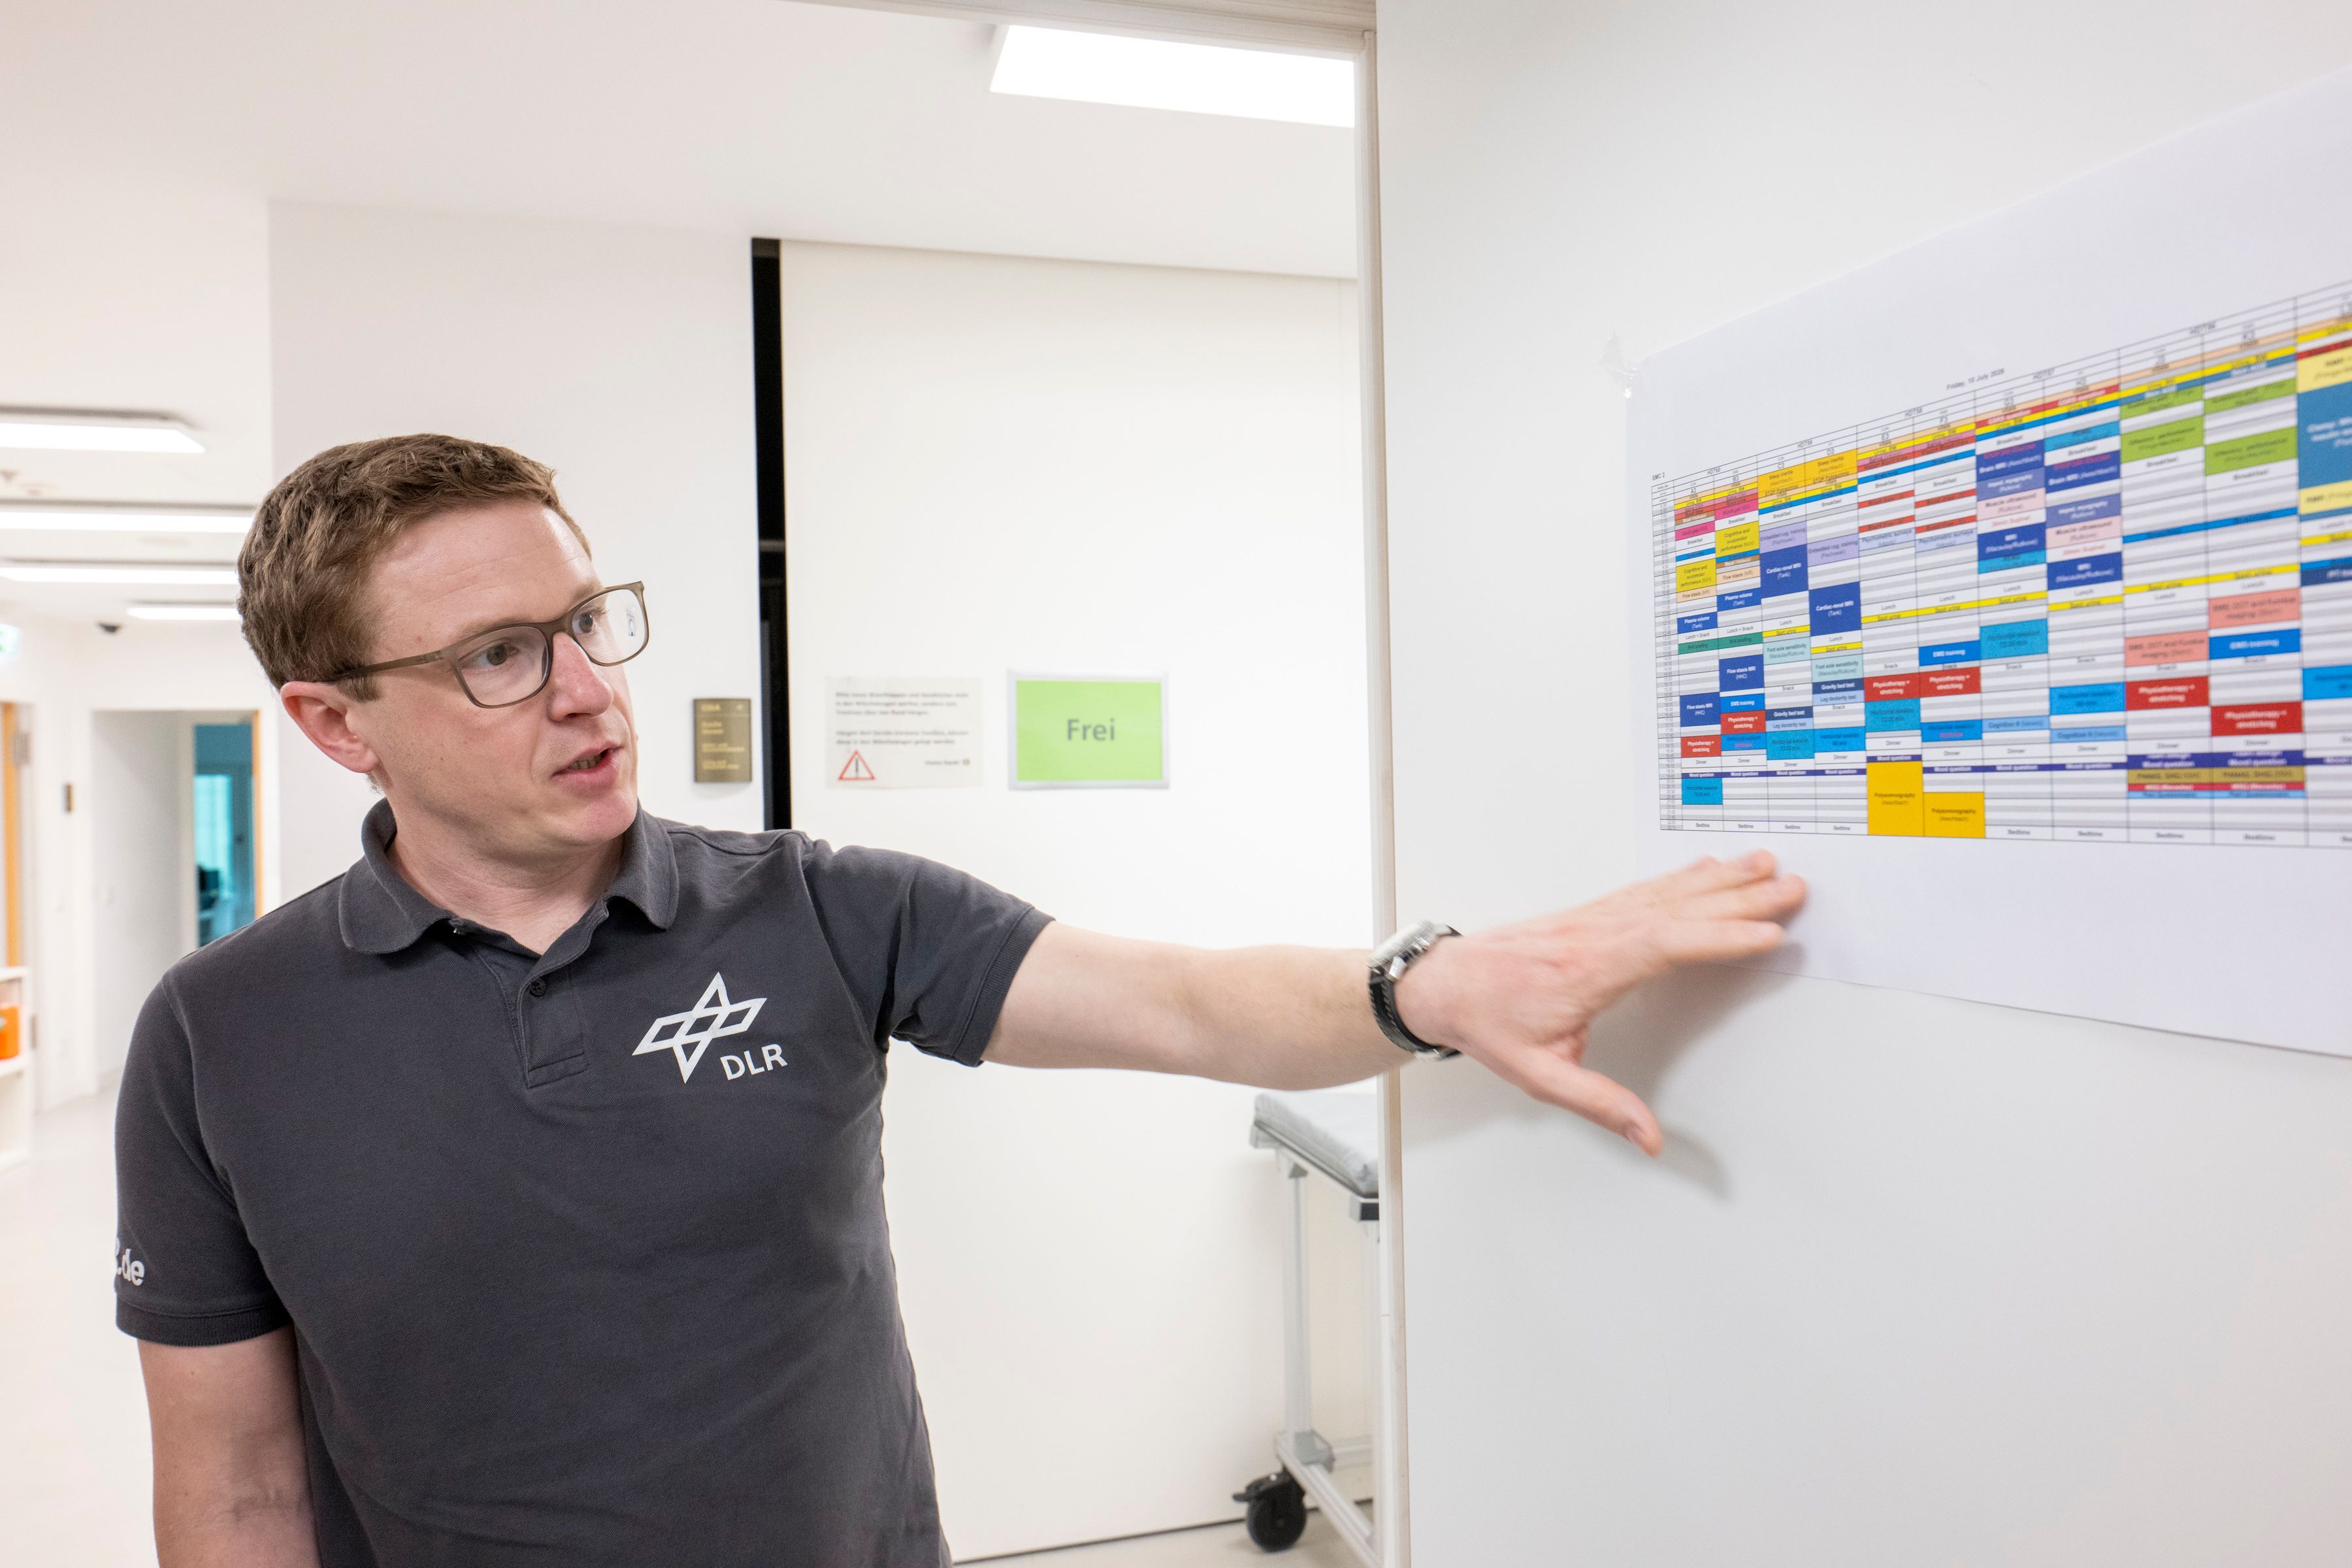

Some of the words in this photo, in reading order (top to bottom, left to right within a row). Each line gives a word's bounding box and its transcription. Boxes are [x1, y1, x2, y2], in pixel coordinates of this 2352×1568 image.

[1875, 479, 1897, 489] Breakfast
[1821, 498, 1842, 507] Breakfast
[1724, 530, 1741, 538] Cognitive
[1067, 717, 1115, 741] Frei
[720, 1043, 788, 1081] DLR
